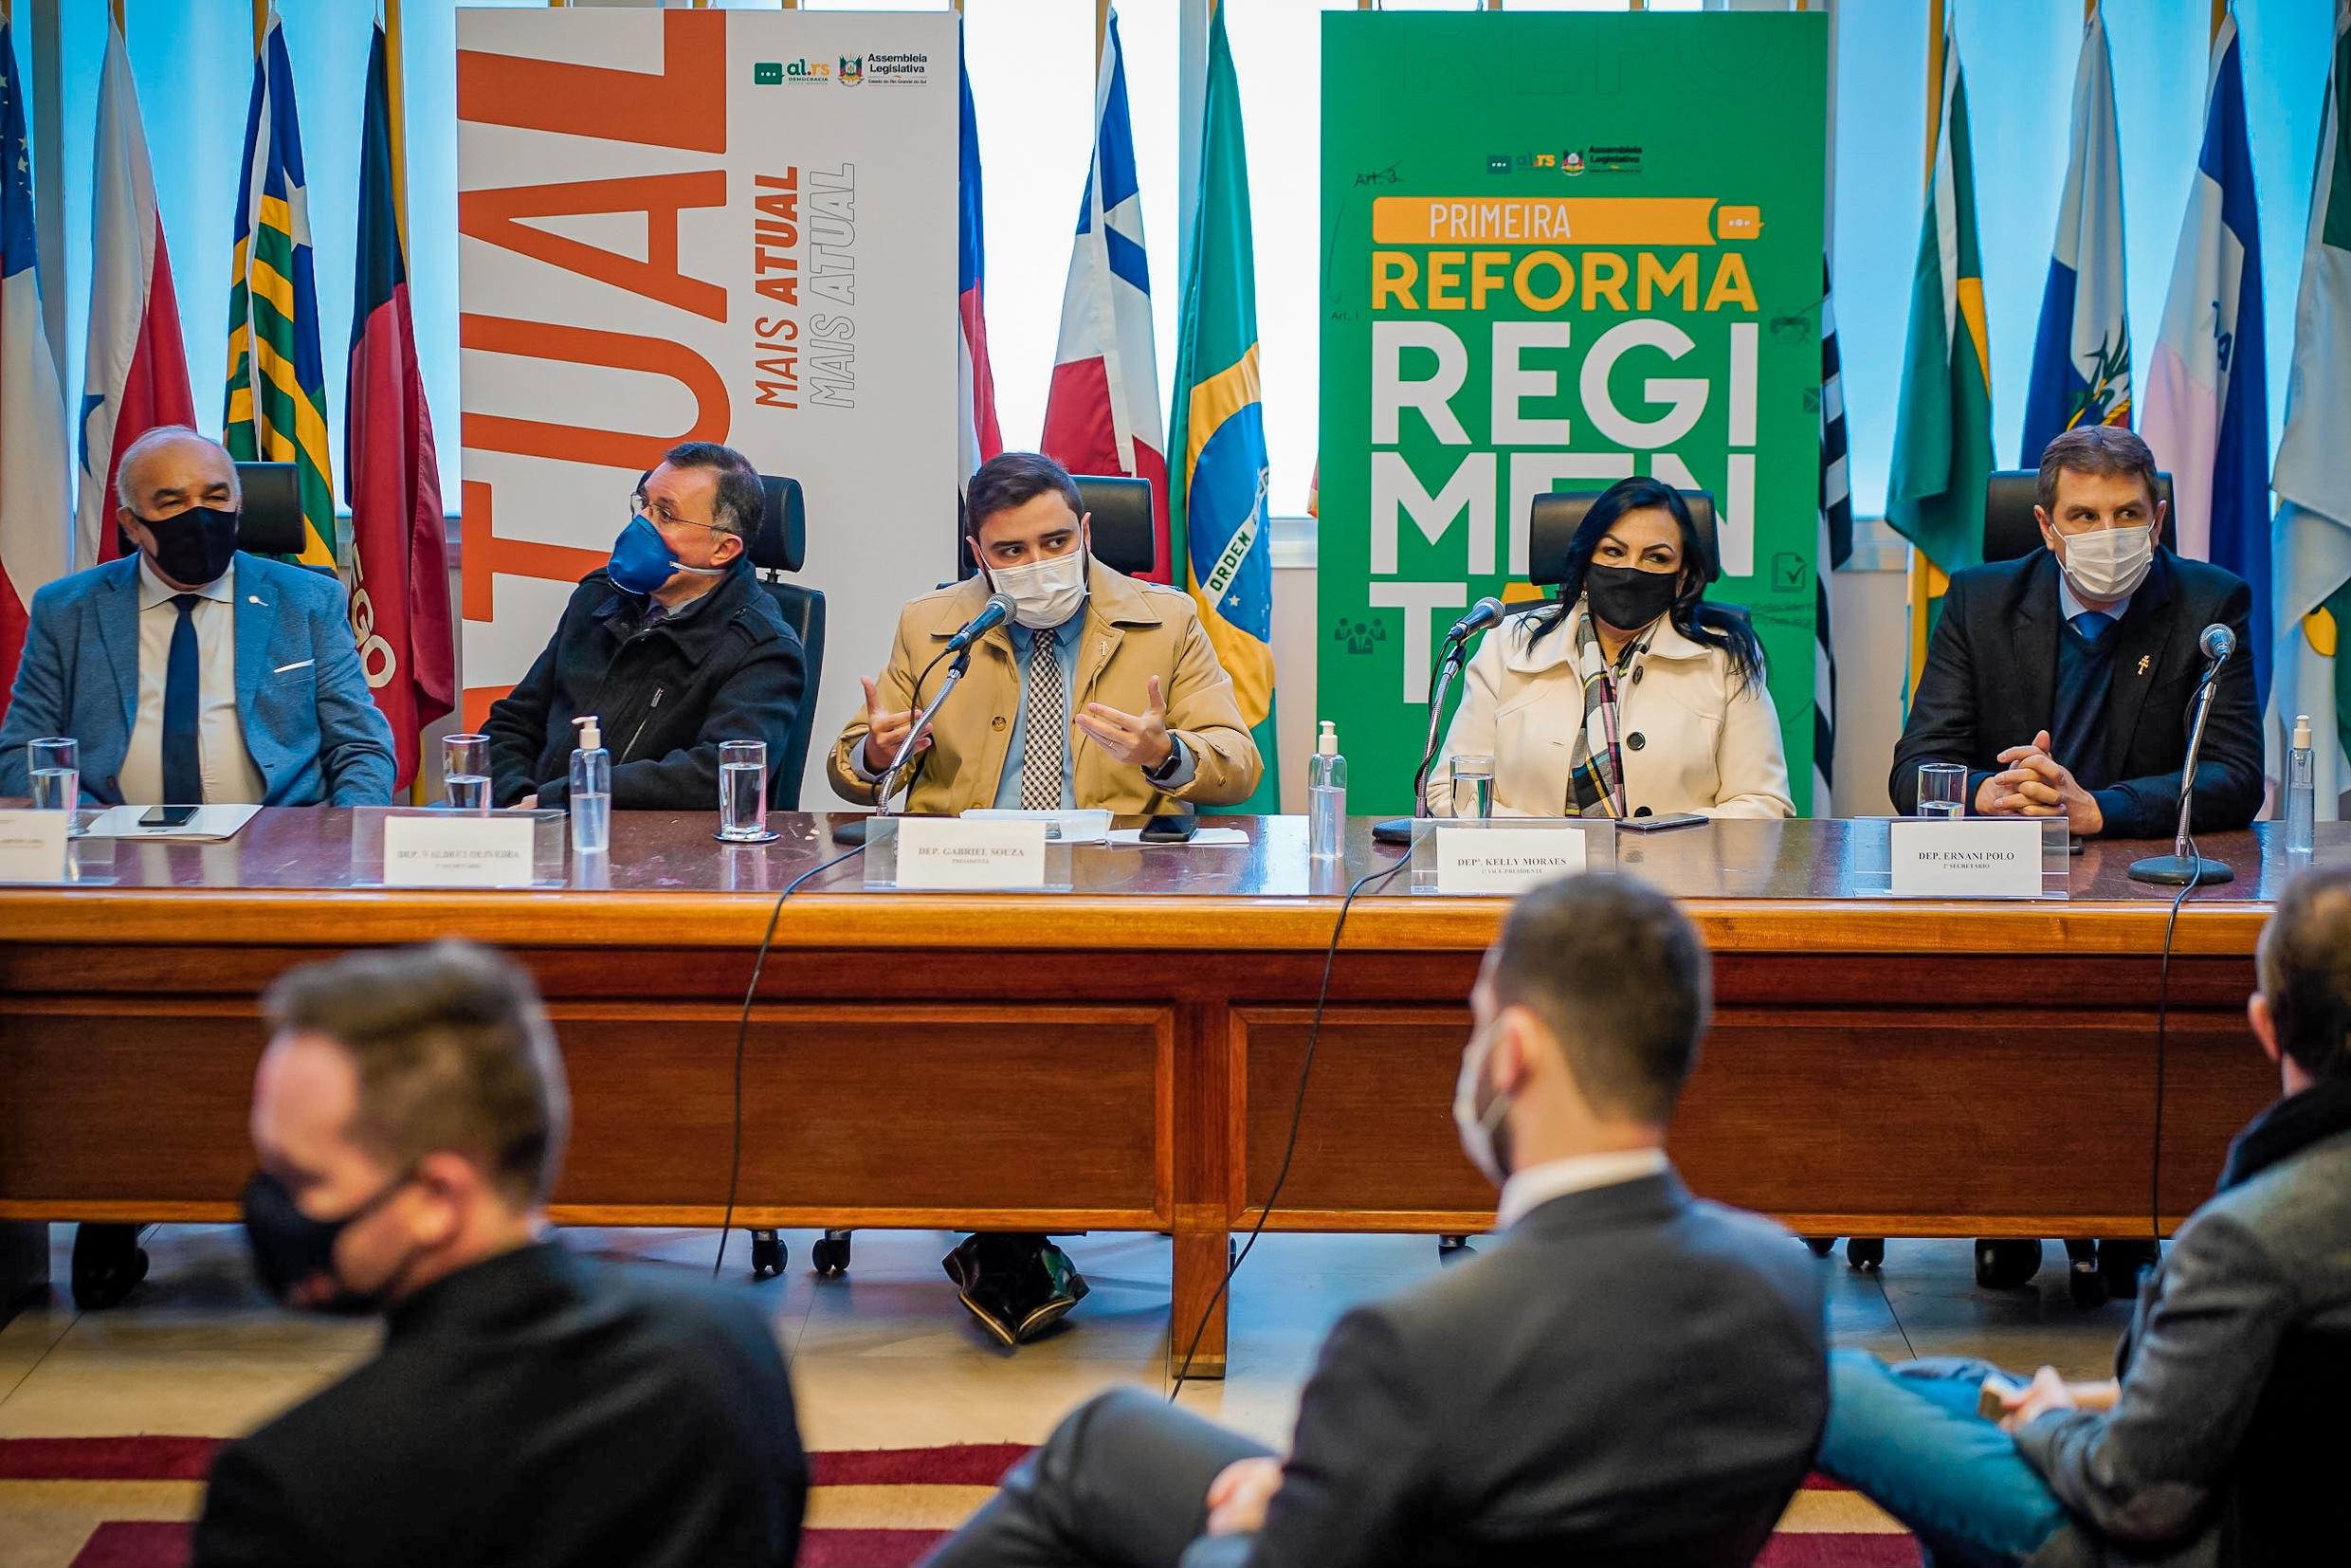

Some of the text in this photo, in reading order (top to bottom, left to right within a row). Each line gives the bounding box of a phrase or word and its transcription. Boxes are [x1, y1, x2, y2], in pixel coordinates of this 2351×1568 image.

[867, 53, 928, 63] Assembleia
[869, 64, 925, 74] Legislativa
[1429, 204, 1572, 239] PRIMEIRA
[755, 166, 798, 409] MAIS ATUAL
[810, 163, 855, 409] MAIS ATUAL
[1371, 250, 1760, 312] REFORMA
[456, 9, 732, 734] TUAL
[1371, 319, 1759, 449] REGI
[1209, 531, 1251, 593] ORDEM
[942, 848, 987, 856] GABRIEL
[991, 848, 1025, 857] SOUZA
[1522, 857, 1567, 866] MORAES
[1919, 851, 2014, 860] DEP. ERNANI POLO
